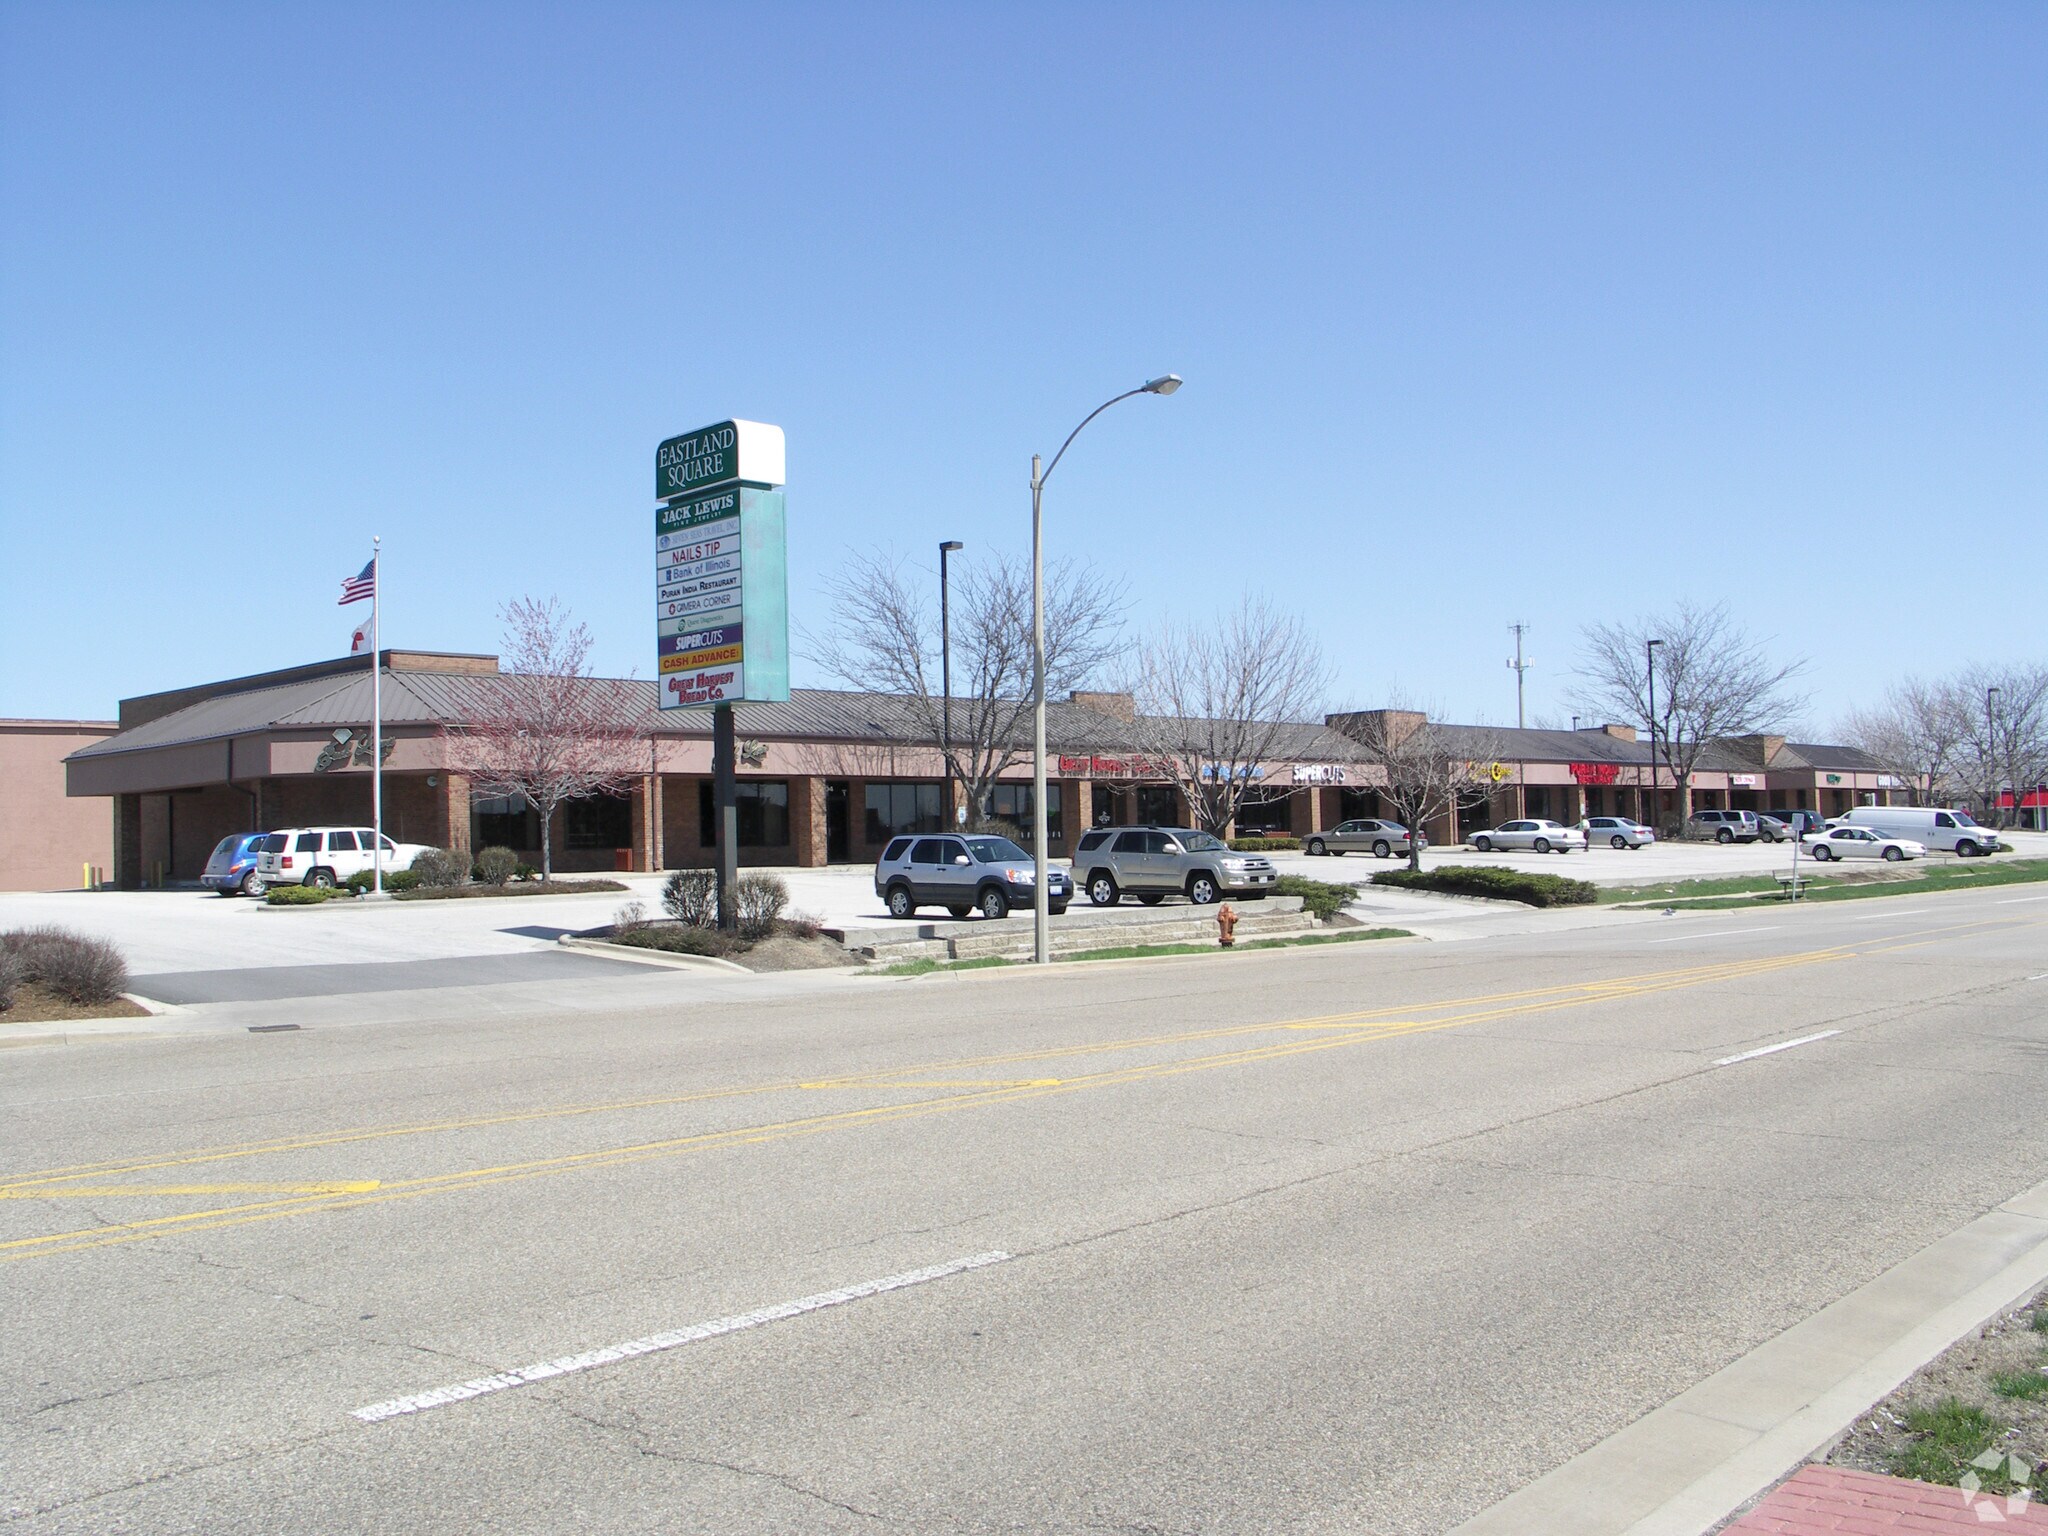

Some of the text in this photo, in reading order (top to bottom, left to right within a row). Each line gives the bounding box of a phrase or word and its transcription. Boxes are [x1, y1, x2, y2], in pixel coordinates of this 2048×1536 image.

[660, 428, 735, 468] EASTLAND
[668, 453, 723, 487] SQUARE
[662, 494, 734, 524] JACK LEWIS
[672, 541, 720, 563] NAILS TIP
[673, 558, 731, 580] Bank of Illinois
[677, 593, 731, 614] CAMERA CORNER
[675, 629, 723, 651] SUPERCUTS
[663, 648, 736, 669] CASH ADVANCE
[1293, 764, 1346, 781] SUPERCUTS
